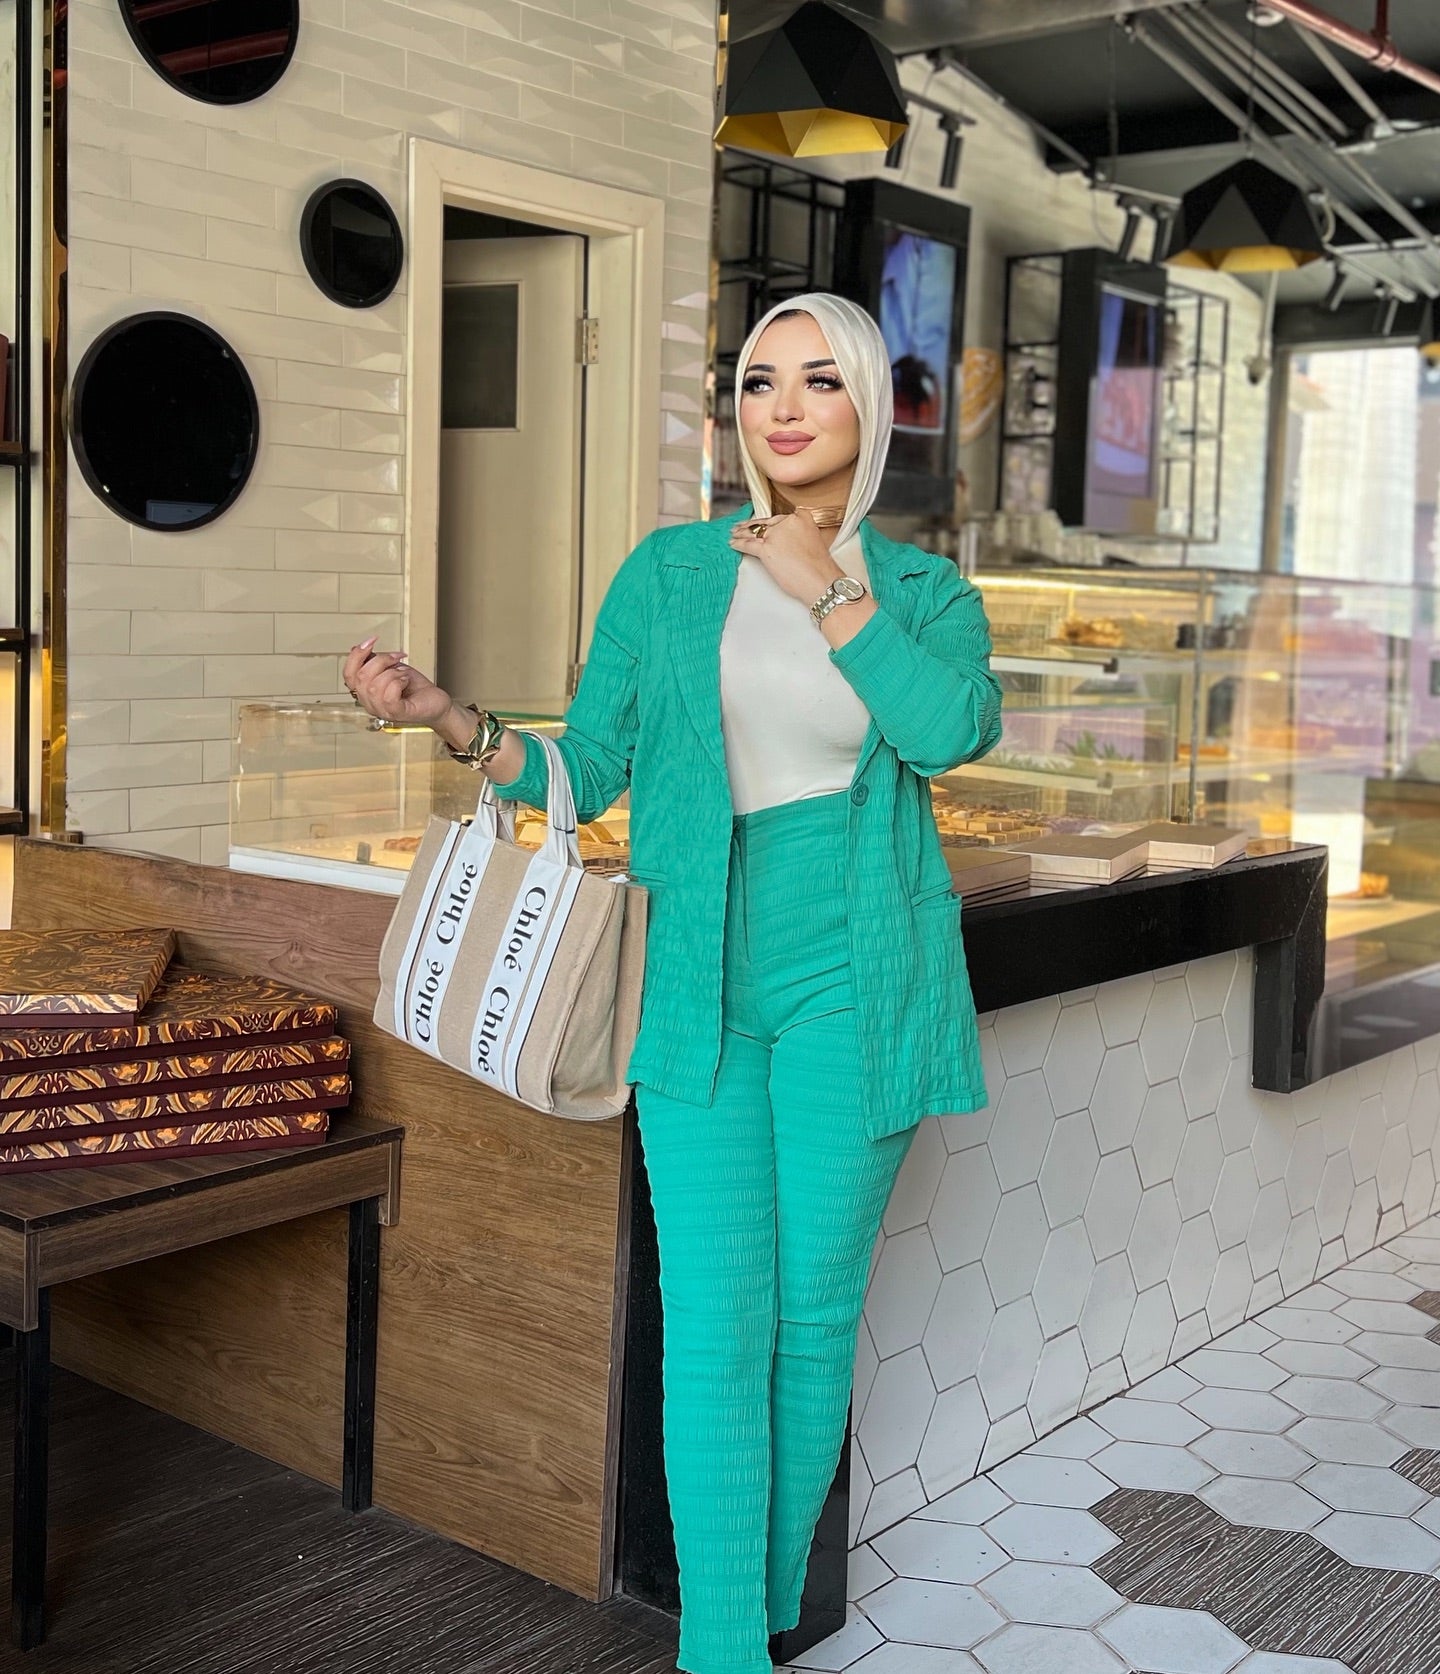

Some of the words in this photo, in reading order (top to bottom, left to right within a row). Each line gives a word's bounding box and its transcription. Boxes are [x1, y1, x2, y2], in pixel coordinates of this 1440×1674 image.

[415, 958, 444, 1043] Chloé
[436, 862, 478, 945] Chloé
[503, 886, 547, 973] Chloé
[477, 986, 510, 1075] Chloé
